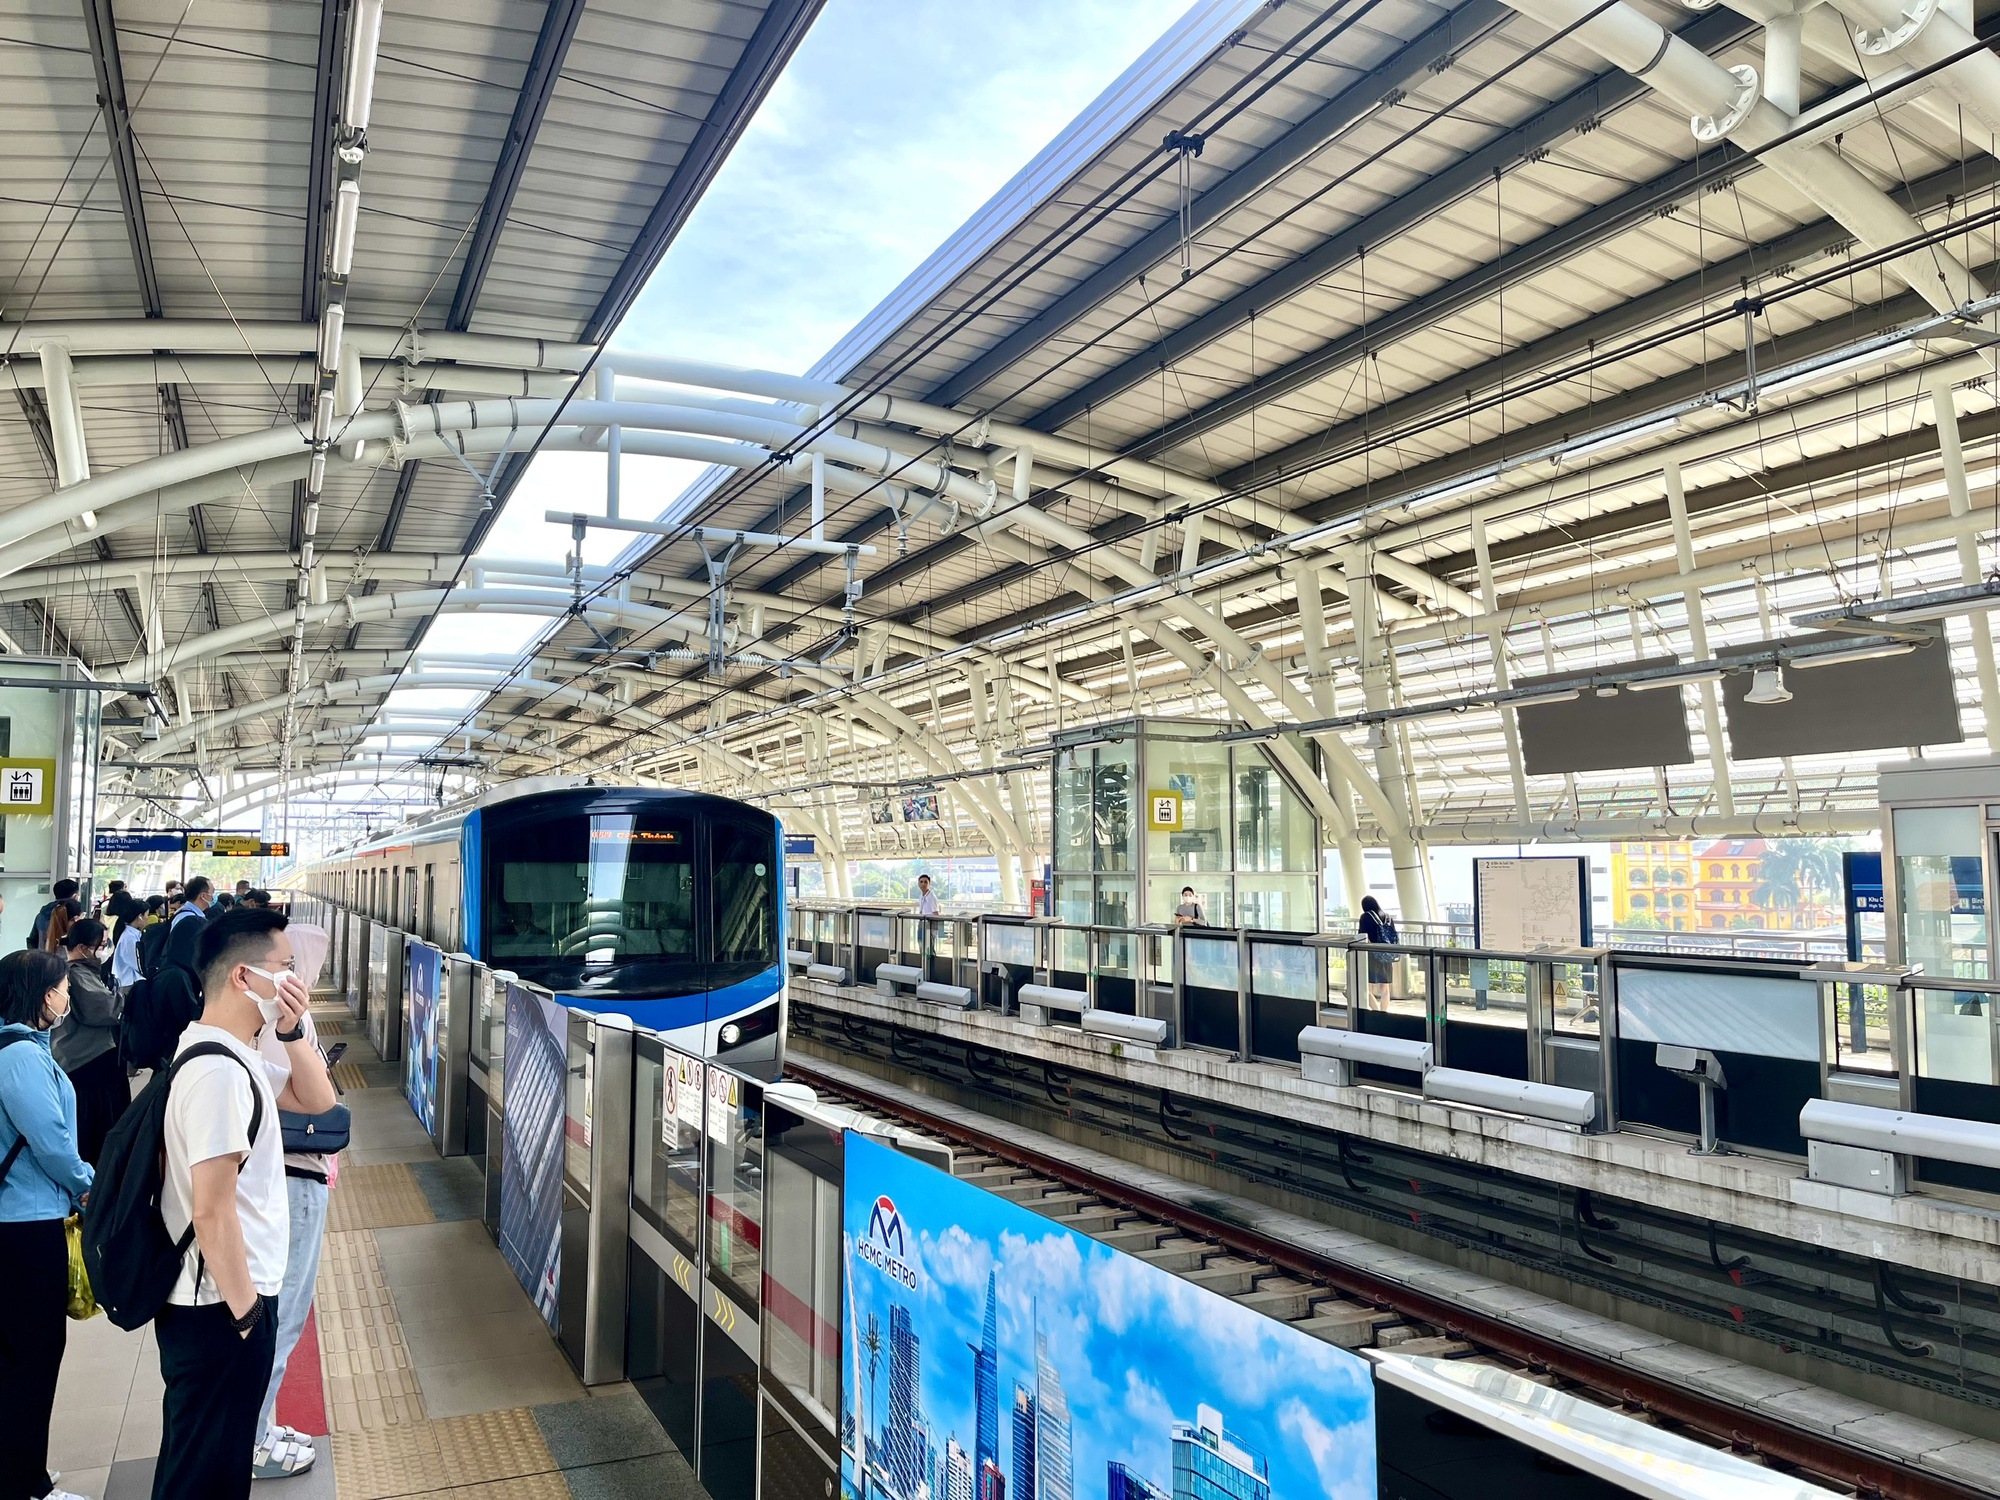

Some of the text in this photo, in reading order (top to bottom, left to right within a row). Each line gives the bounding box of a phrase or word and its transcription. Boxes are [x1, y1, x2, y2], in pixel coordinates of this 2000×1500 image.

[1486, 861, 1490, 869] 2
[858, 1238, 917, 1290] HCMC METRO
